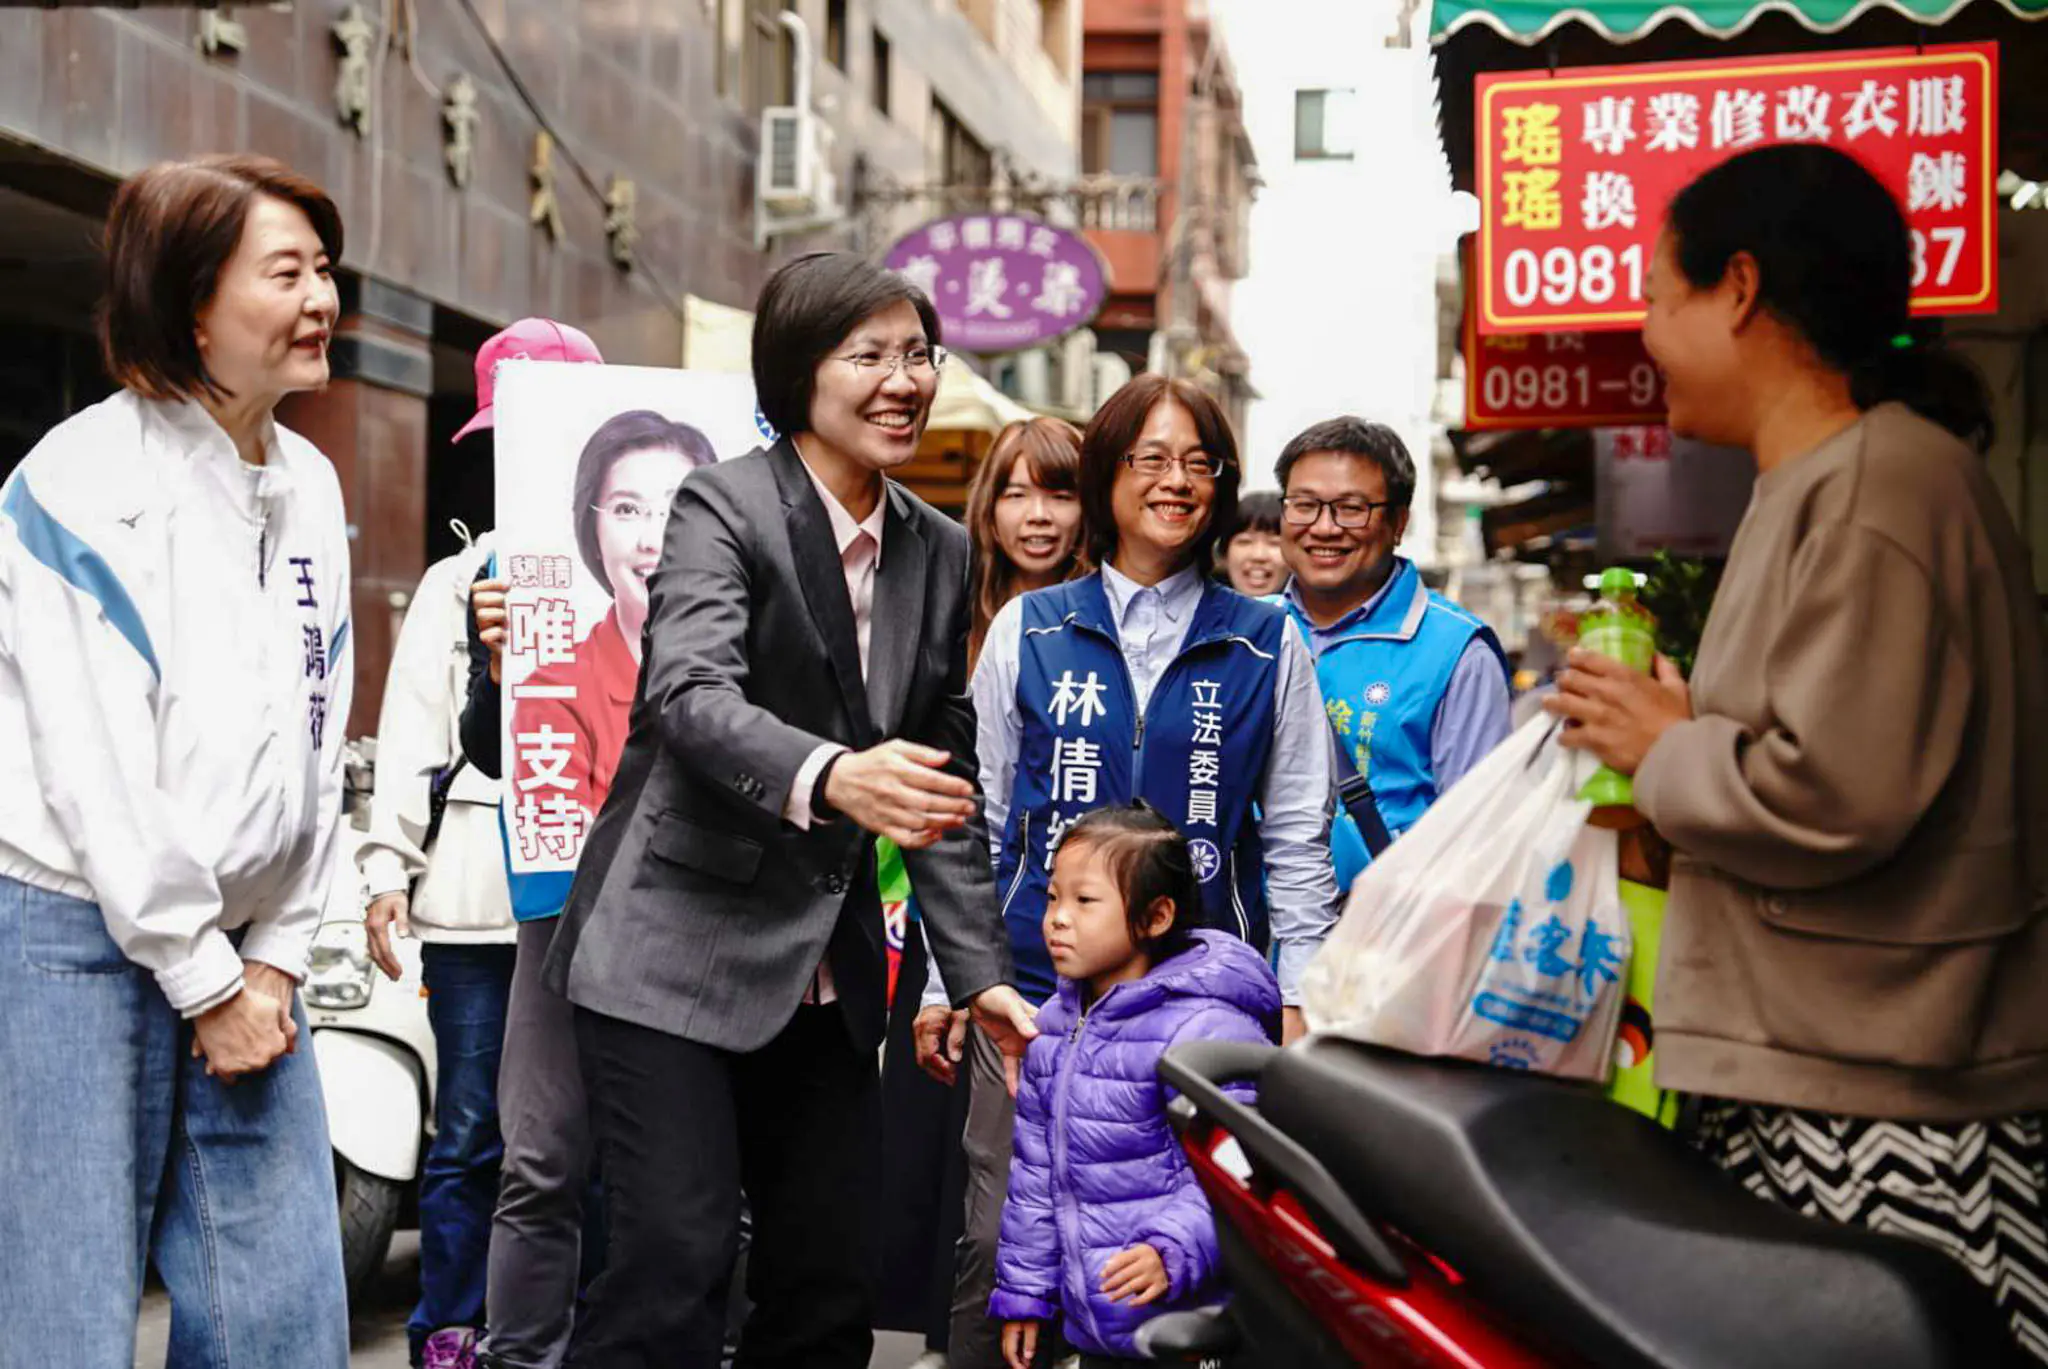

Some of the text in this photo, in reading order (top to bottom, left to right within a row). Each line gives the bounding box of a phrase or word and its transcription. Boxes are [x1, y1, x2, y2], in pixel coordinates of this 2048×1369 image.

[1501, 102, 1562, 230] 瑤瑤
[1581, 75, 1967, 155] 專業修改衣服
[1580, 151, 1967, 231] 換 鍊
[1503, 243, 1644, 308] 0981
[509, 596, 585, 861] 唯一支持
[1185, 679, 1223, 827] 立法委員
